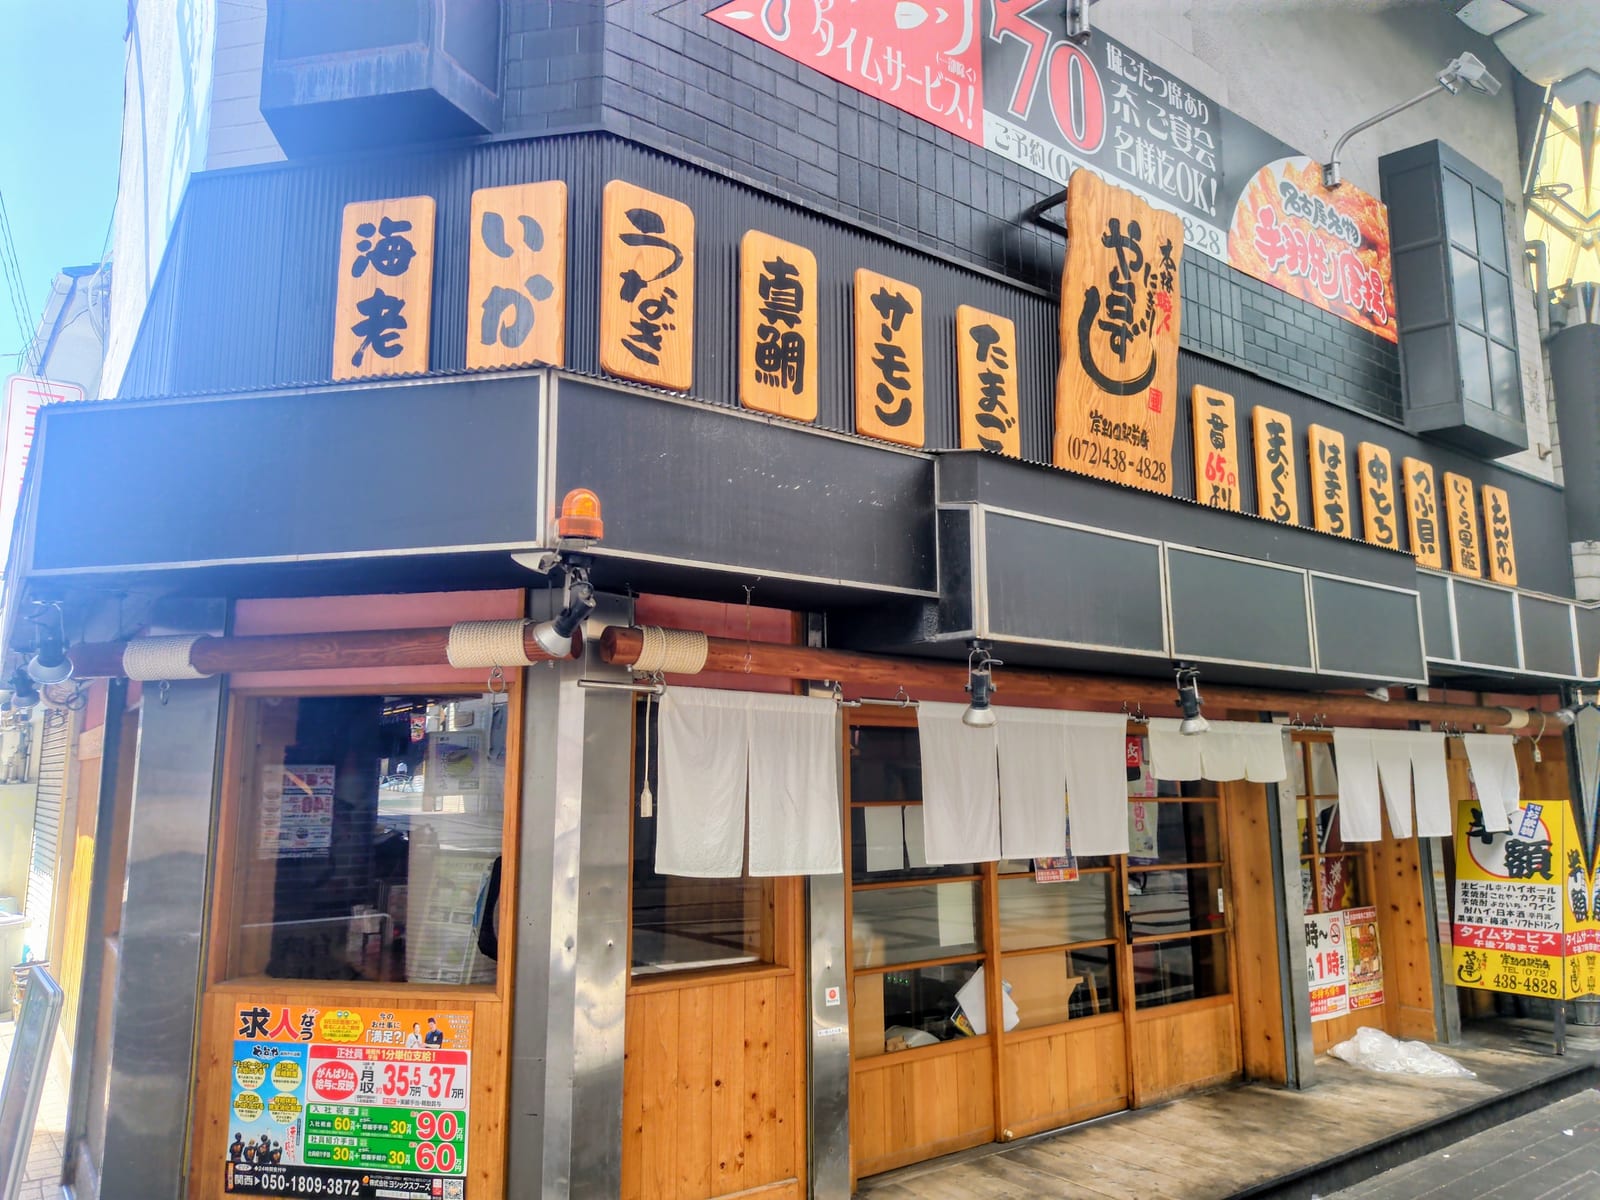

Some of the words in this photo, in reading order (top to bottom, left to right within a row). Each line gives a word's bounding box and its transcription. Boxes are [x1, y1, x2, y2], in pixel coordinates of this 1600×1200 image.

[1278, 180, 1362, 248] 名古屋名物
[351, 216, 417, 368] 海老
[481, 211, 554, 349] いか
[619, 208, 684, 366] うなぎ
[755, 255, 805, 395] 真鯛
[870, 286, 914, 427] サーモン
[969, 324, 1016, 453] たまご
[1067, 434, 1167, 484] (072)438-4828
[1265, 418, 1291, 522] まぐろ
[1319, 440, 1344, 533] はまち
[1367, 453, 1393, 544] 中とろ
[1412, 469, 1435, 555] つぶ貝
[1308, 958, 1315, 981] AM
[1460, 926, 1556, 945] タイムサービス
[1474, 939, 1539, 953] 午後7時まで
[1503, 966, 1519, 975] TEL
[1522, 968, 1549, 978] (072)
[1493, 974, 1557, 995] 438-4828
[336, 1048, 363, 1060] 正社員
[312, 1105, 356, 1115] 入社祝金
[262, 1173, 359, 1196] 050-1809-3872
